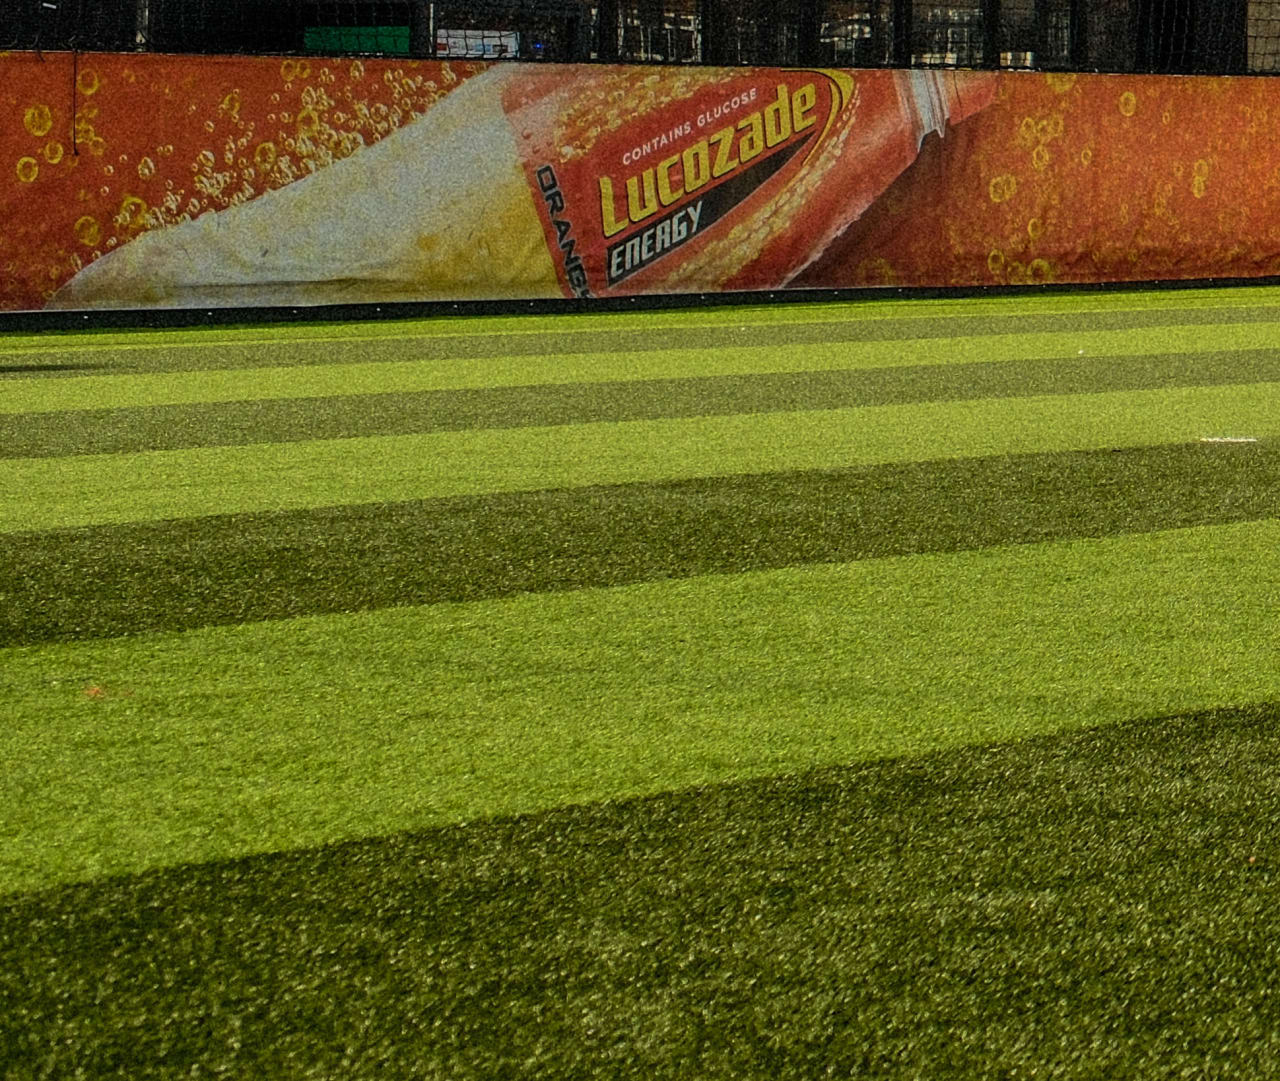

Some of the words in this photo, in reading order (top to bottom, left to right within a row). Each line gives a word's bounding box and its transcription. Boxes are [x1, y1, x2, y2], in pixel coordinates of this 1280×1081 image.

[599, 83, 817, 238] Lucozade
[622, 121, 692, 166] CONTAINS
[696, 87, 758, 128] GLUCOSE
[610, 200, 703, 278] ENERGY
